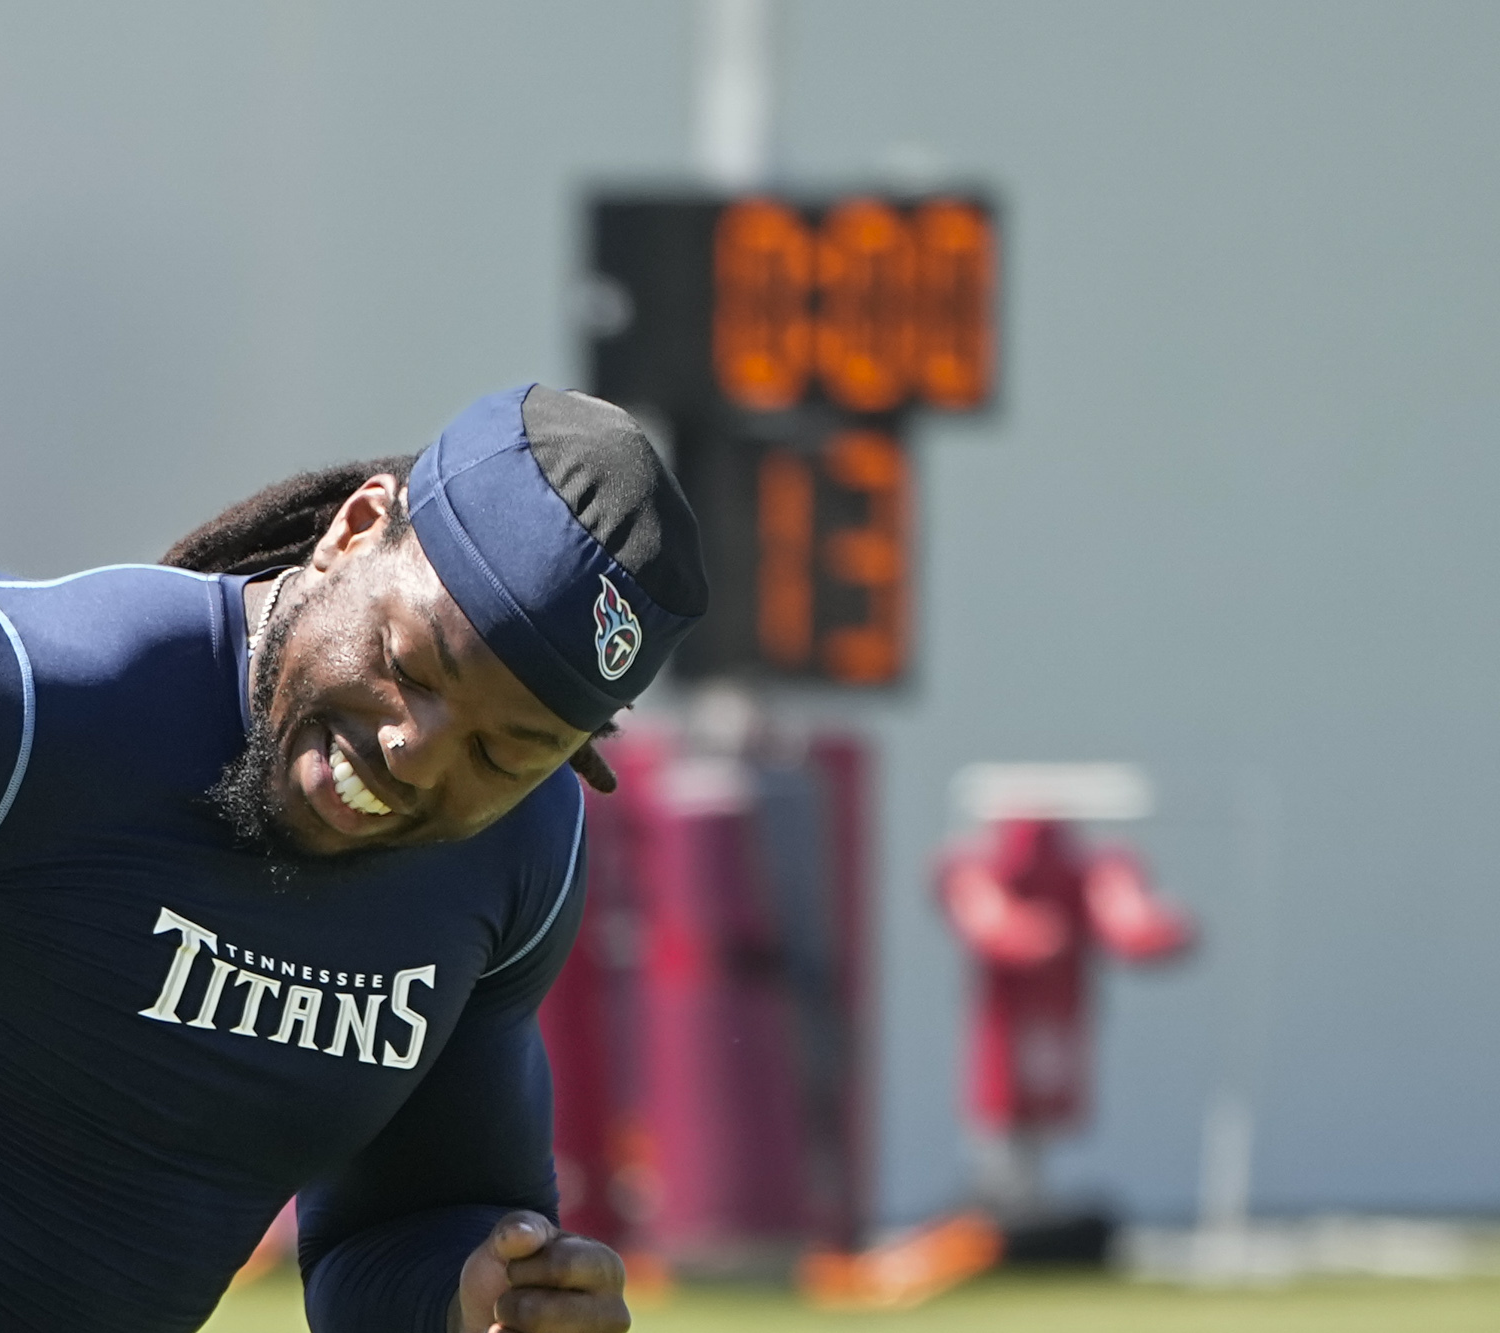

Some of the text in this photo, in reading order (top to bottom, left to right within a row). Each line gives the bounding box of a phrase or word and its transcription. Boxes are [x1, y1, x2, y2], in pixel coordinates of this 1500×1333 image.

[757, 429, 918, 687] 13
[137, 906, 437, 1071] TITANS
[225, 943, 384, 989] TENNESSEE
